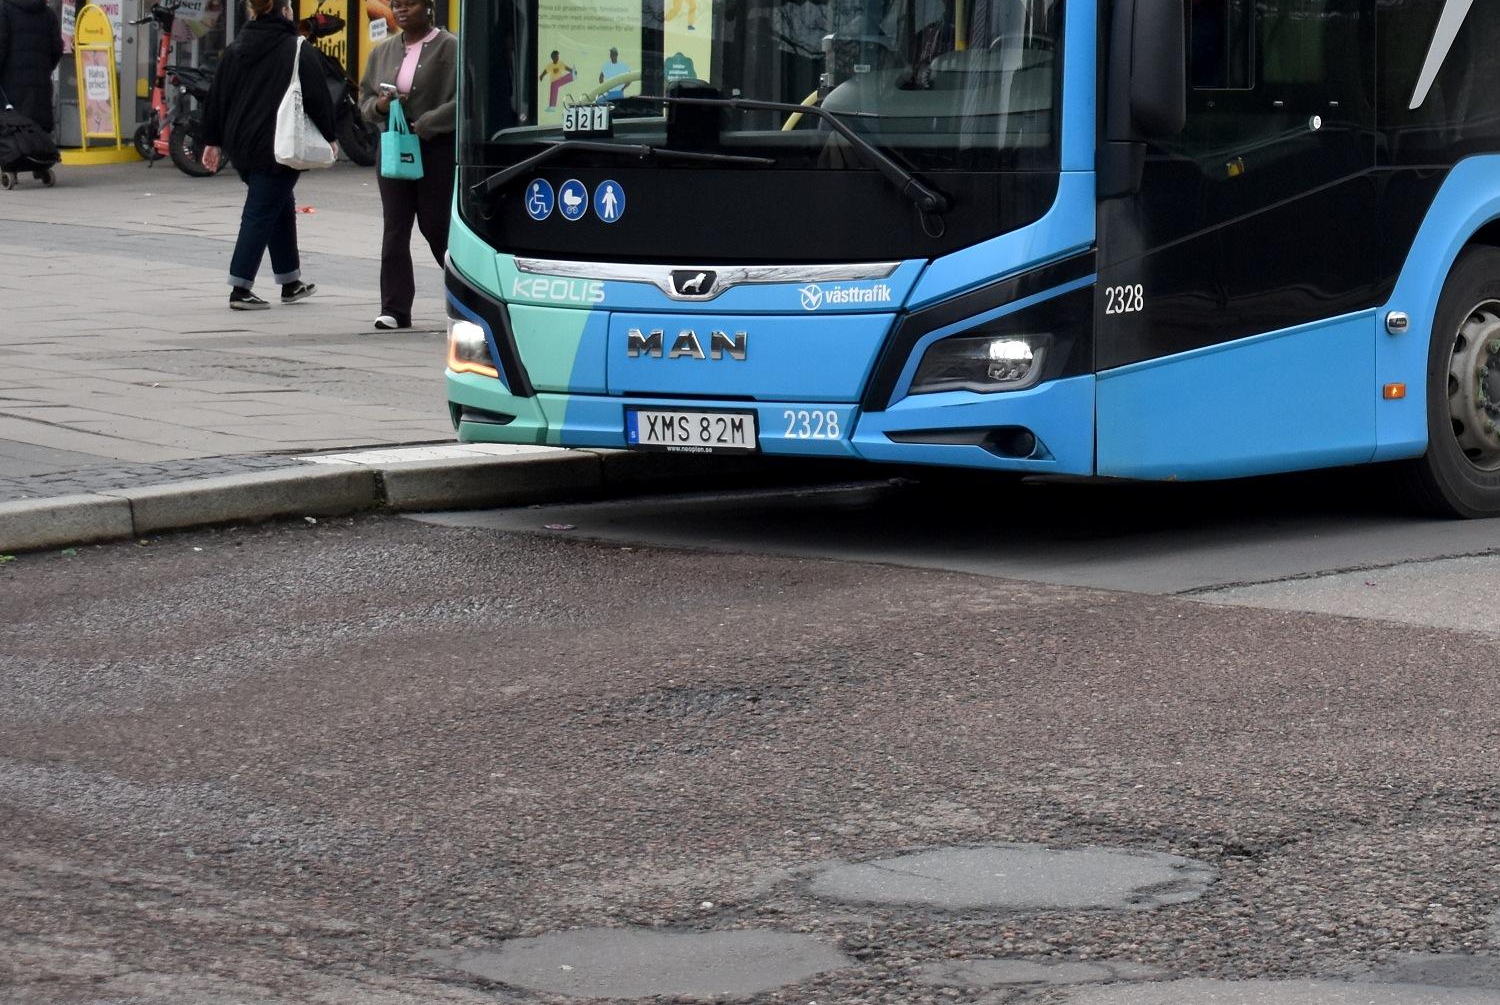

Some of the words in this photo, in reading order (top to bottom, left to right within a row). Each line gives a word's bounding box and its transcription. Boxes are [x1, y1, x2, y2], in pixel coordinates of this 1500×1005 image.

[565, 113, 604, 129] 521
[825, 284, 891, 304] västtrafik
[1105, 283, 1144, 315] 2328
[627, 329, 747, 361] MAN
[646, 414, 690, 442] XMS
[699, 416, 746, 444] 82M
[783, 410, 840, 439] 2328
